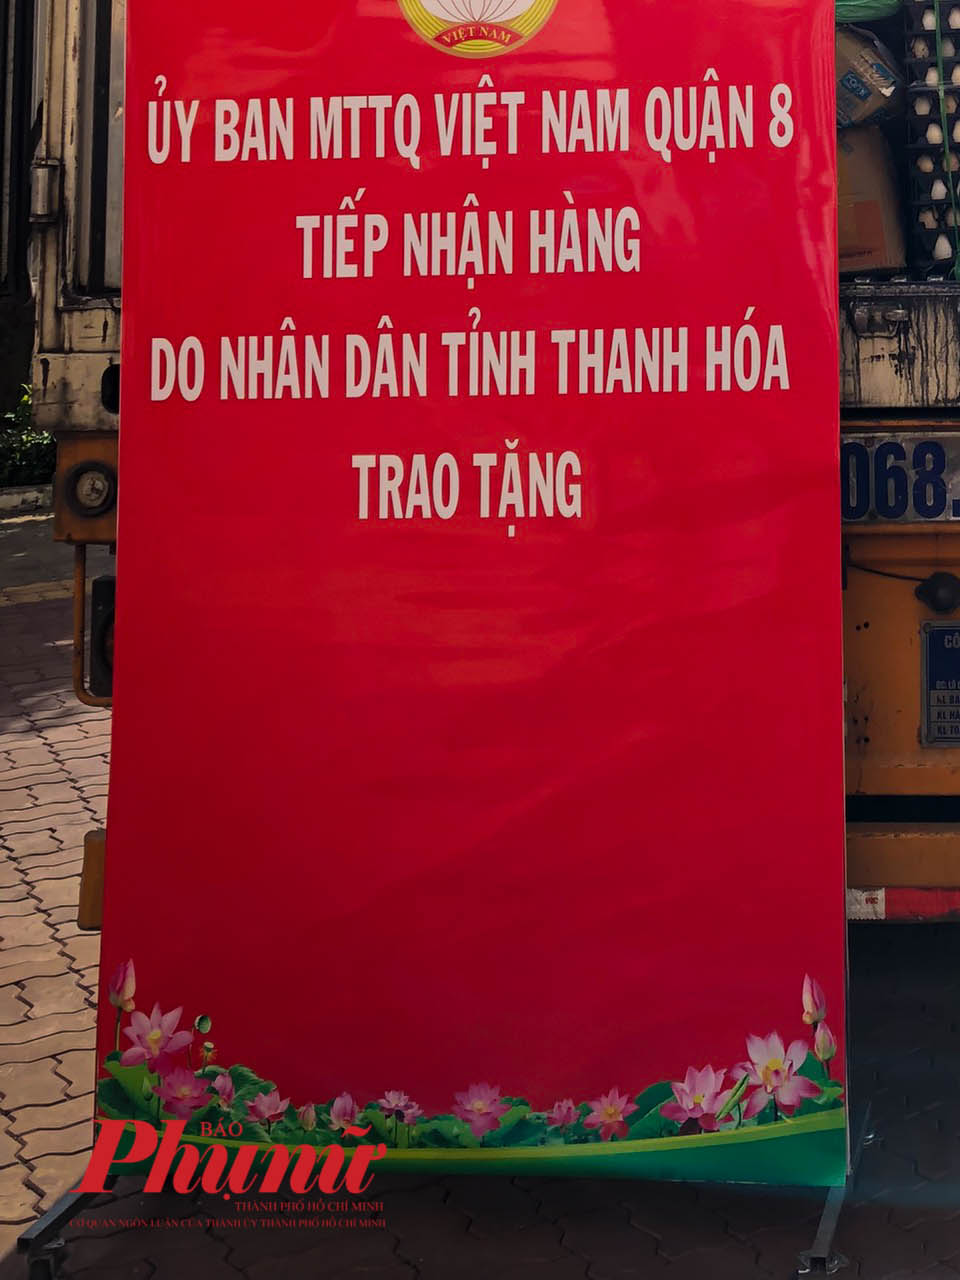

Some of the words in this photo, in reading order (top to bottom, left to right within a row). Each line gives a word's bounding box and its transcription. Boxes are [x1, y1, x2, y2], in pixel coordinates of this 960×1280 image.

[442, 26, 476, 43] VIỆT
[478, 26, 512, 43] NAM
[147, 75, 199, 164] ỦY
[214, 97, 294, 162] BAN
[309, 94, 421, 168] MTTQ
[435, 74, 525, 169] VIỆT
[541, 88, 630, 154] NAM
[644, 68, 754, 163] QUẬN
[768, 83, 795, 148] 8
[296, 188, 389, 279] TIẾP
[403, 193, 514, 290] NHẬN
[530, 191, 641, 274] HÀNG
[150, 336, 204, 401] DO
[219, 317, 329, 401] NHÂN
[346, 315, 427, 399] DÂN
[441, 307, 536, 396] TỈNH
[551, 326, 688, 395] THANH
[704, 306, 790, 392] HÓA
[351, 451, 459, 520] TRAO
[473, 438, 582, 538] TẶNG
